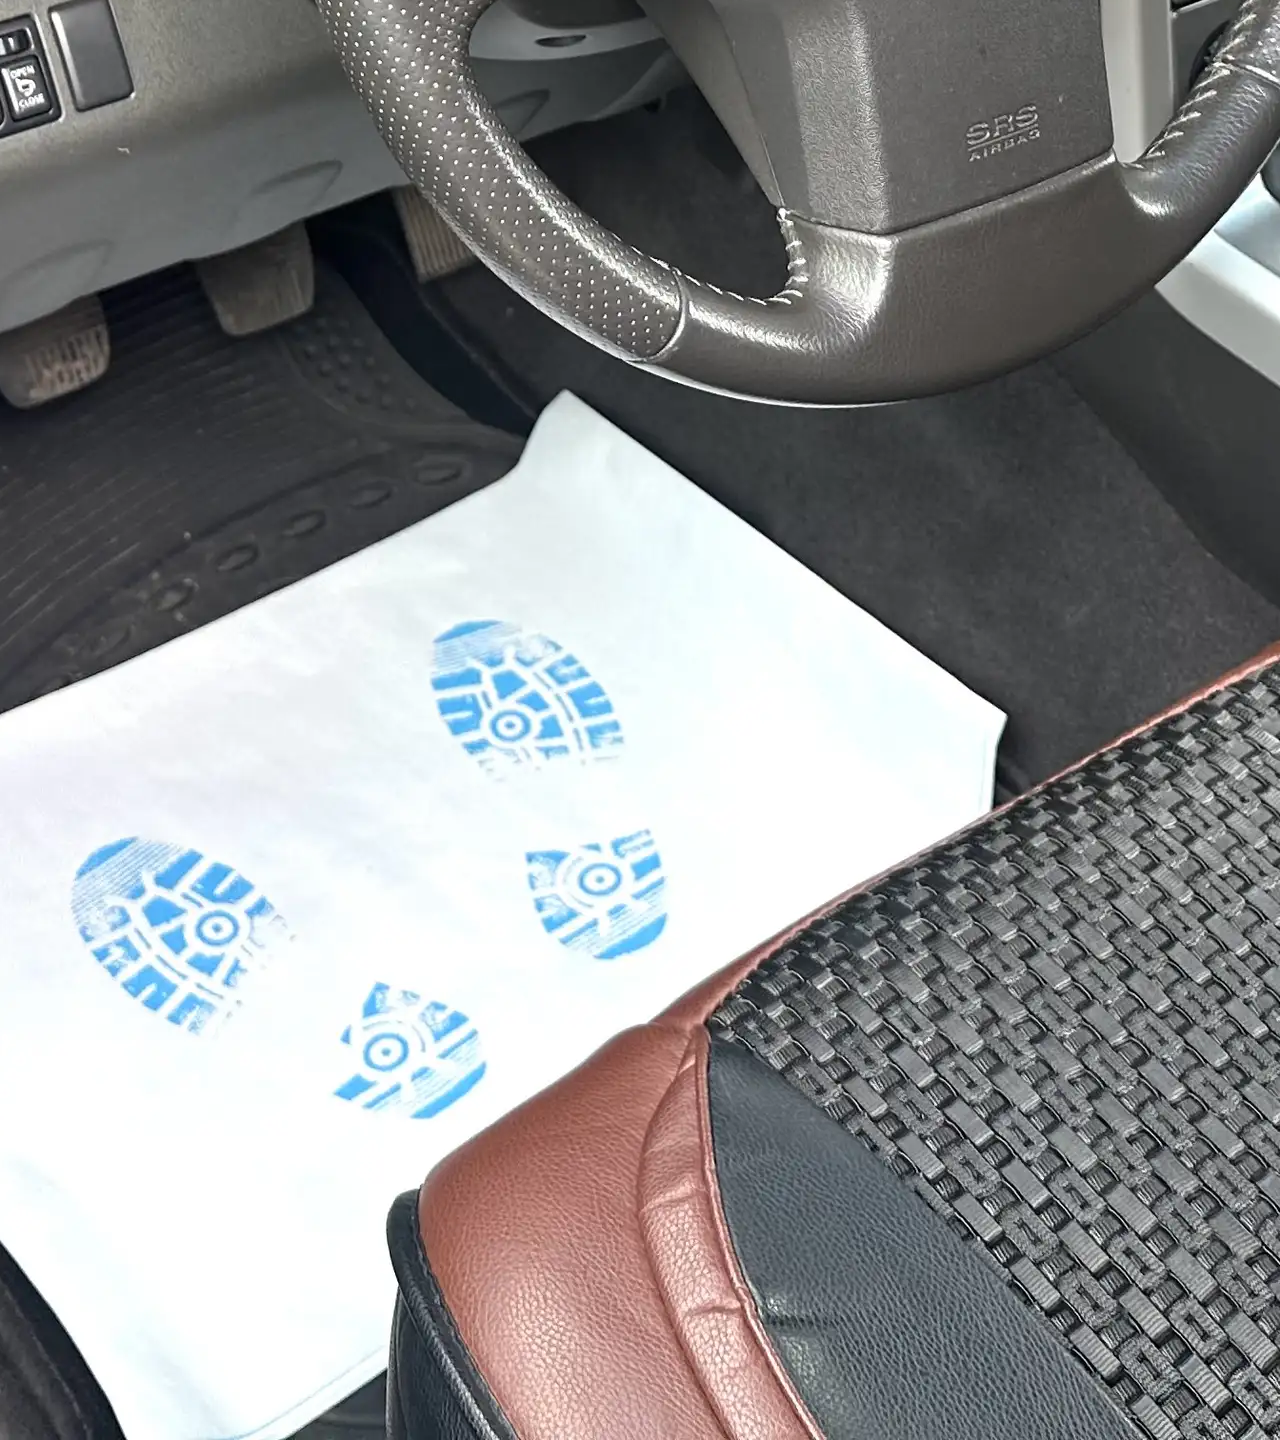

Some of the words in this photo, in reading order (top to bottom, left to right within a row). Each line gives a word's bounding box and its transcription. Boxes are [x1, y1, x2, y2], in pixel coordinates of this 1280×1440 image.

[9, 64, 35, 79] OPEN
[18, 92, 45, 109] CLOSE
[966, 105, 1039, 145] SRS
[969, 129, 1040, 162] AIRBAG
